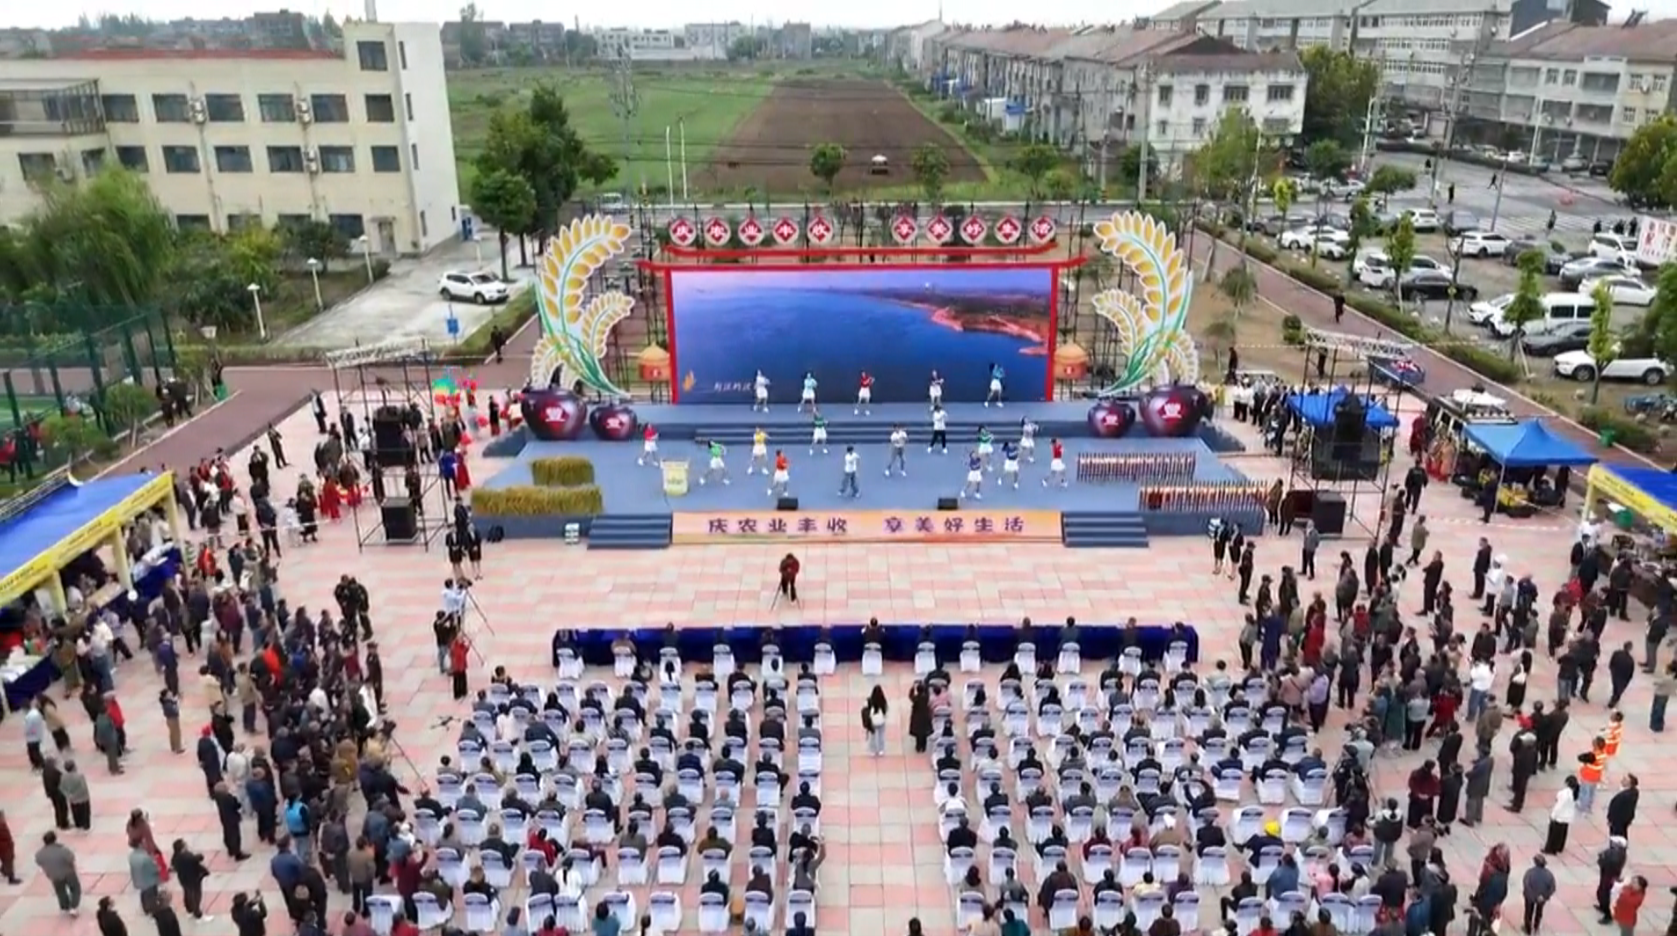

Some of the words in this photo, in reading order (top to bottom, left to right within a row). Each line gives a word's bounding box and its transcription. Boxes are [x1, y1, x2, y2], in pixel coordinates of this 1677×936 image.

[896, 220, 1053, 238] 享美好生活
[708, 517, 848, 534] 庆农业丰收
[884, 516, 1024, 533] 享美好生活
